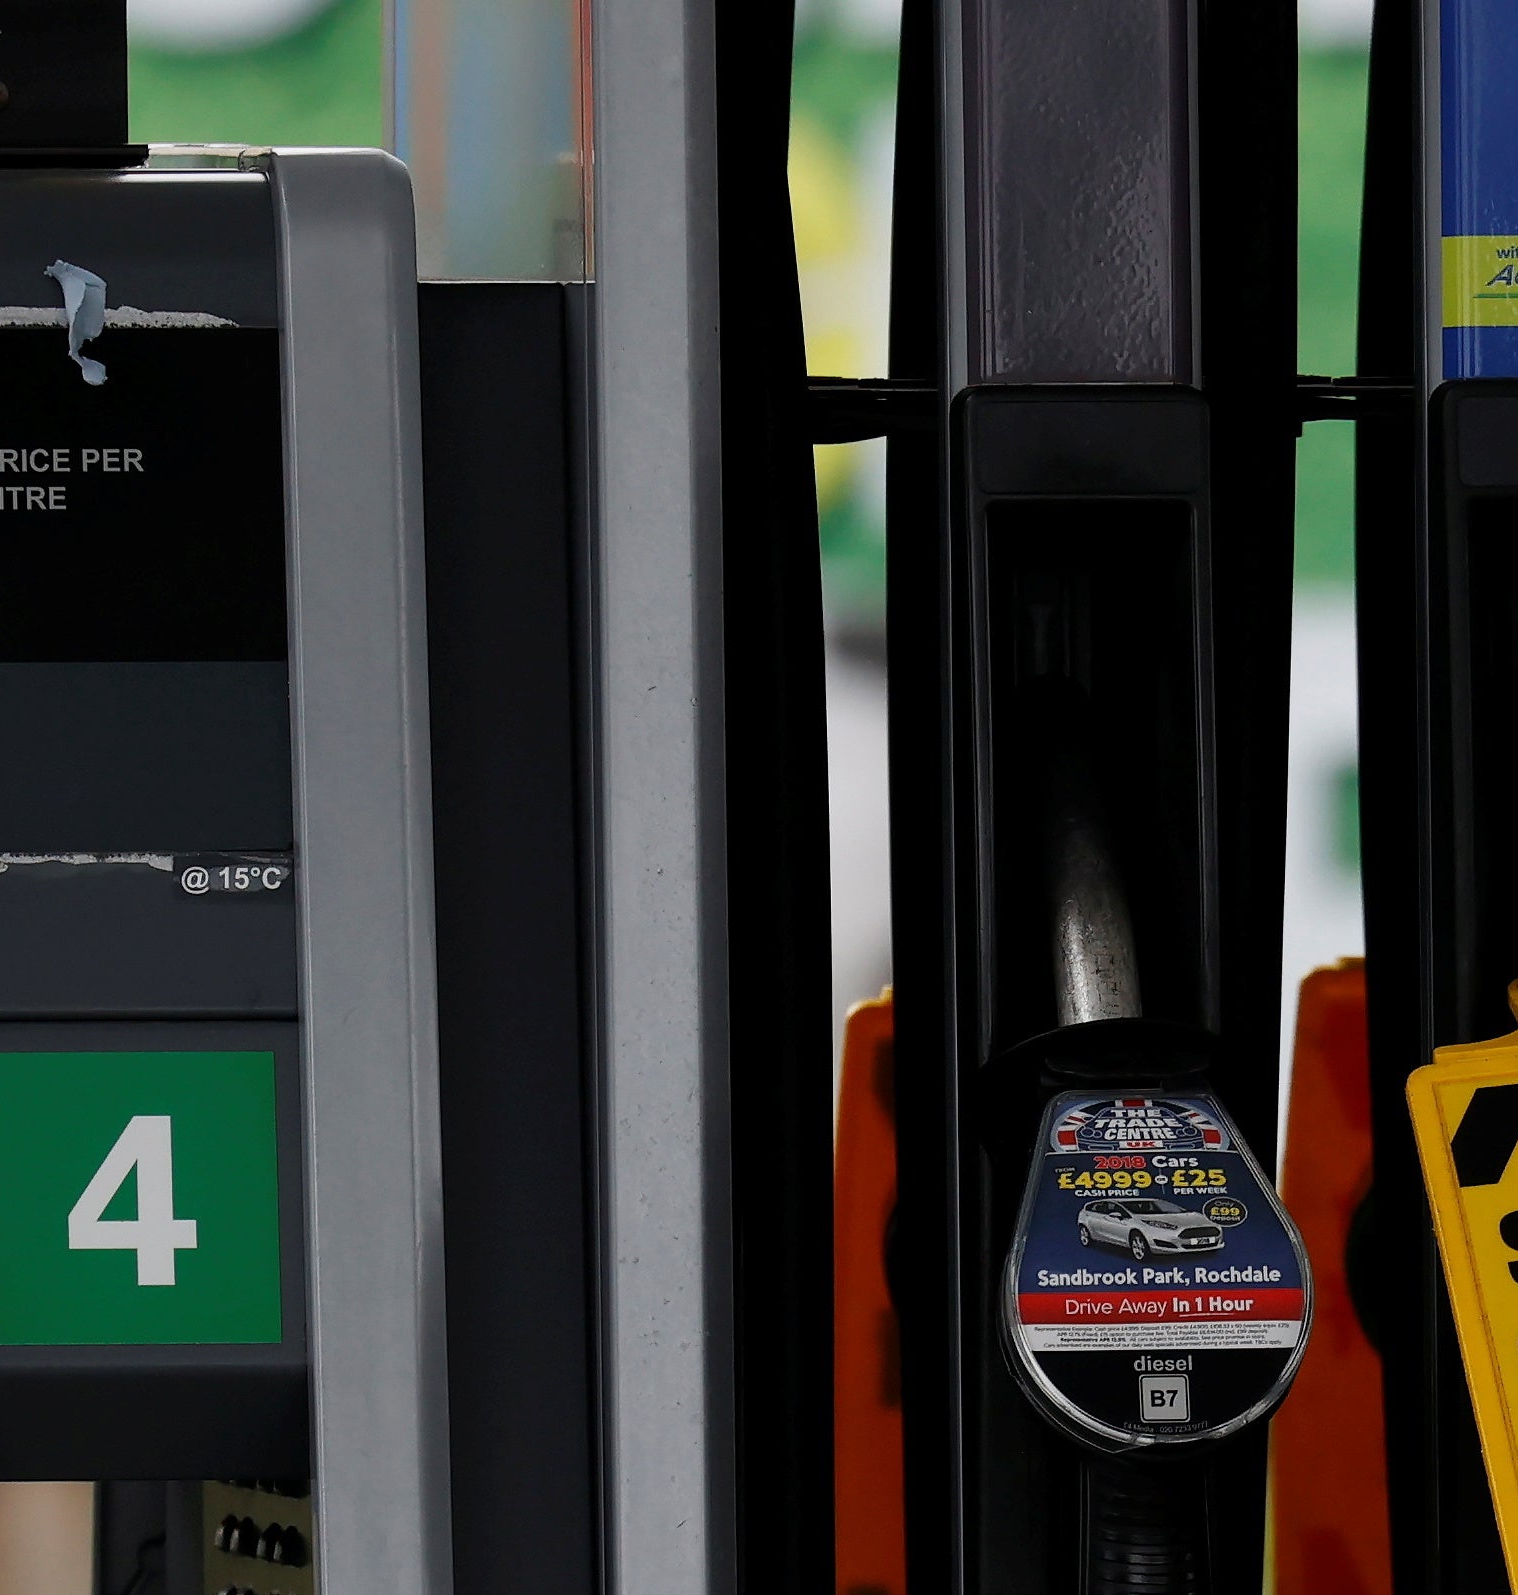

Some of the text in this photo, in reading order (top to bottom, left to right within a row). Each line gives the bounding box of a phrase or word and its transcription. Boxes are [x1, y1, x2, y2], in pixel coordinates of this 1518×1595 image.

[82, 449, 144, 472] PER
[182, 867, 281, 894] @ 15°C
[1110, 1109, 1161, 1117] THE
[1094, 1118, 1182, 1129] TRADE
[1103, 1127, 1179, 1142] CENTRE
[1093, 1155, 1200, 1170] 2018 Cars
[1057, 1170, 1152, 1190] £4999
[1171, 1169, 1228, 1187] £25
[1074, 1189, 1140, 1197] CASH PRICE
[1173, 1186, 1229, 1195] PER WEEK
[68, 1116, 197, 1286] 4
[1038, 1266, 1281, 1286] Sandbrook Park, Rochdale
[1066, 1296, 1253, 1317] Drive Away In 1 Hour
[1134, 1355, 1192, 1371] diesel
[1151, 1390, 1178, 1407] B7
